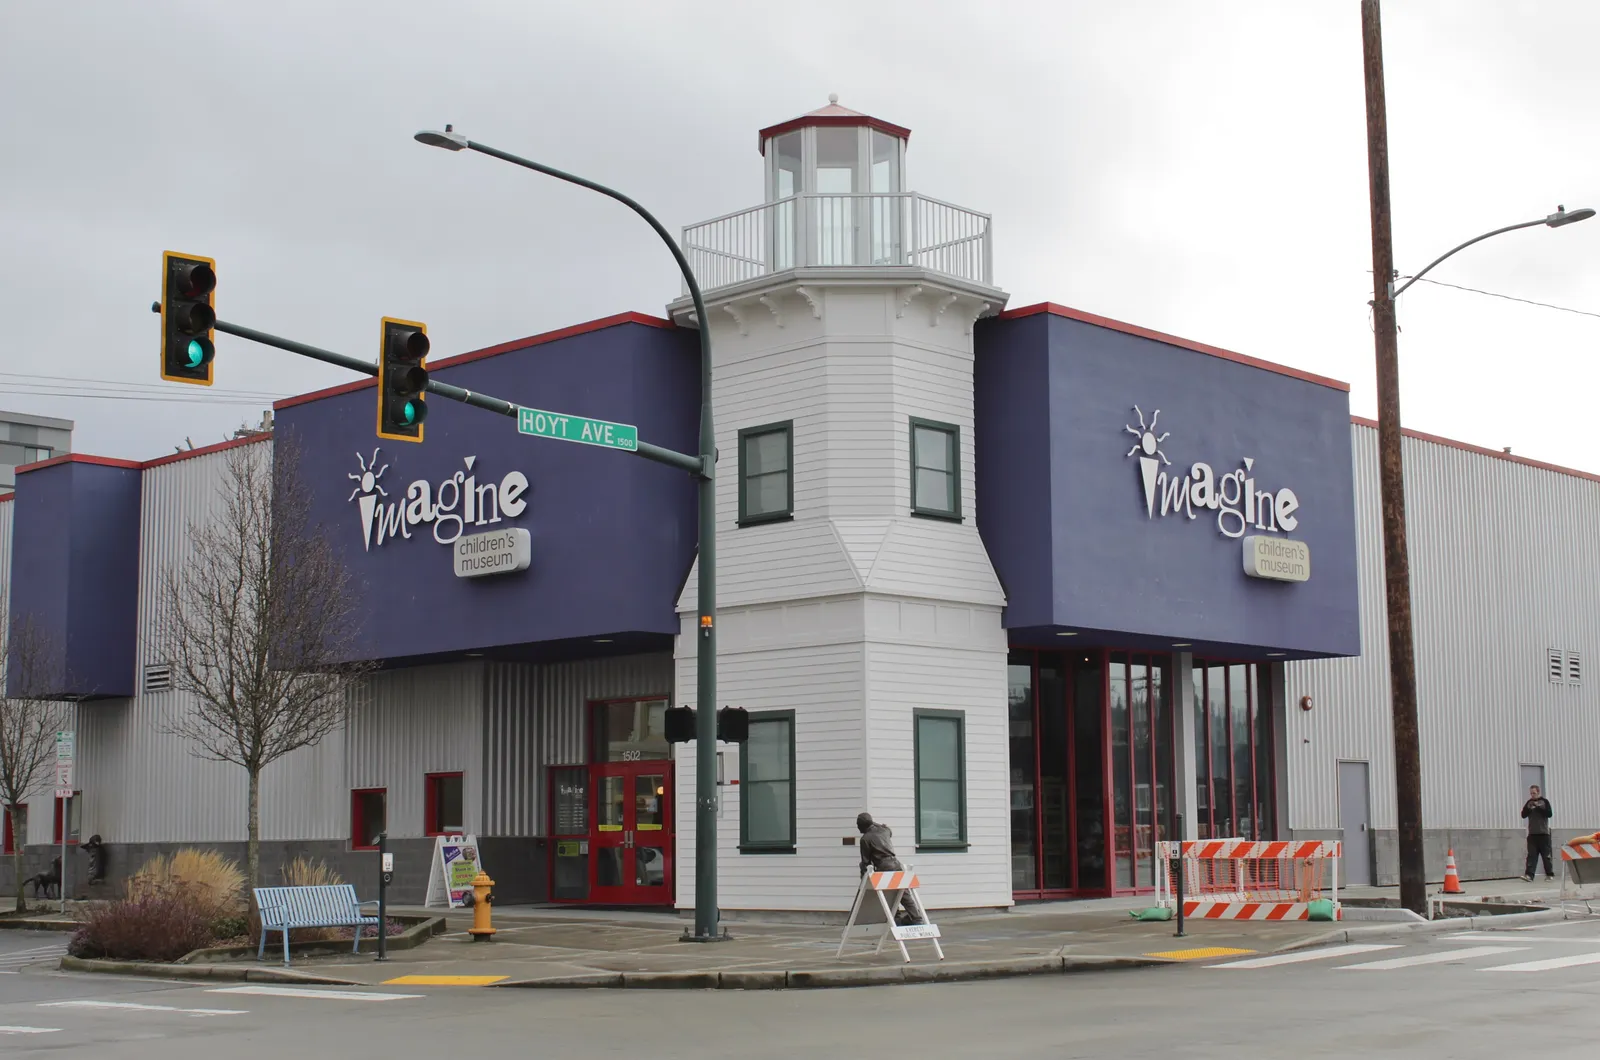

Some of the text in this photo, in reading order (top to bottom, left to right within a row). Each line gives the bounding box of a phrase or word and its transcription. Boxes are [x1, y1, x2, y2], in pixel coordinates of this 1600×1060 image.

[522, 411, 633, 447] HOYT AVE 1500
[1139, 432, 1299, 538] imagine
[359, 455, 529, 553] imagine
[459, 533, 515, 556] children's
[1258, 539, 1305, 560] children's
[461, 551, 513, 572] museum
[1260, 558, 1304, 575] museum
[622, 750, 640, 761] 1502
